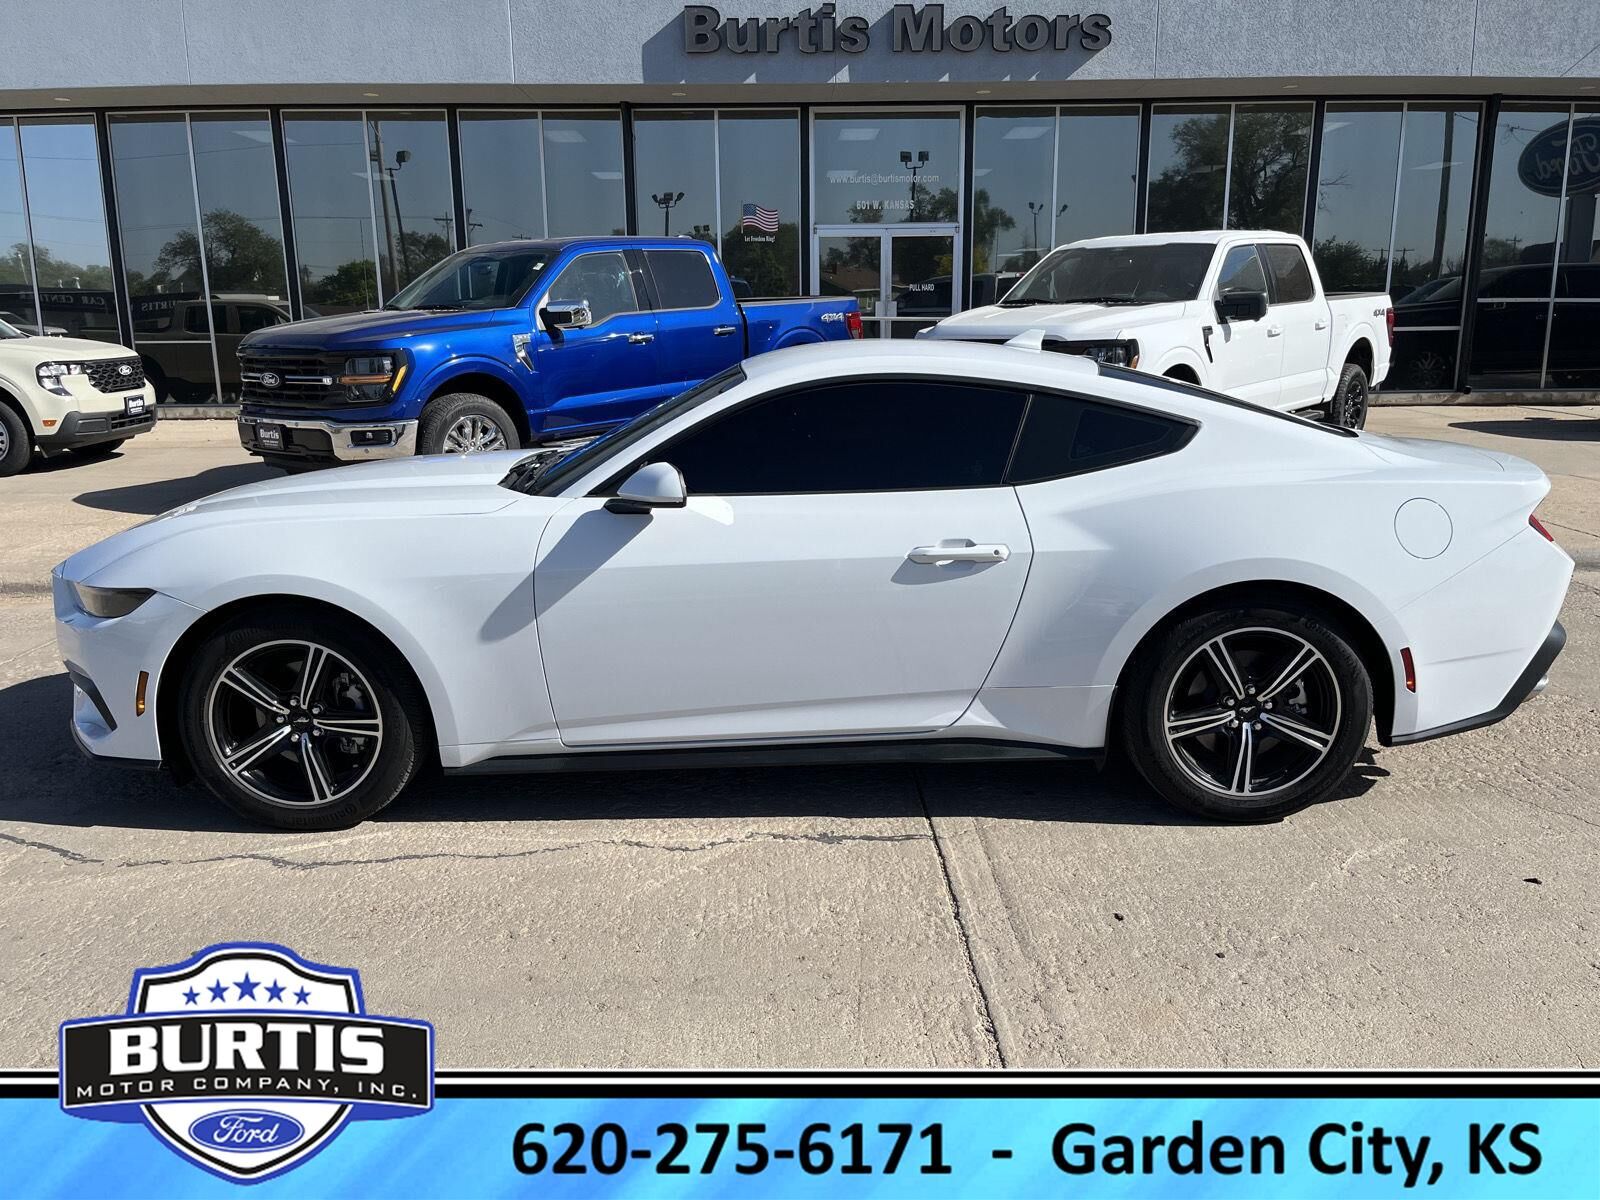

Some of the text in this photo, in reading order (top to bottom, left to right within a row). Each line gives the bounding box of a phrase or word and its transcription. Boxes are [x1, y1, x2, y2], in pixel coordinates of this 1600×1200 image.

[684, 3, 1112, 54] Burtis Motors
[884, 200, 915, 210] KANSAS
[909, 283, 935, 292] PULL HARD
[260, 428, 280, 440] Burtis
